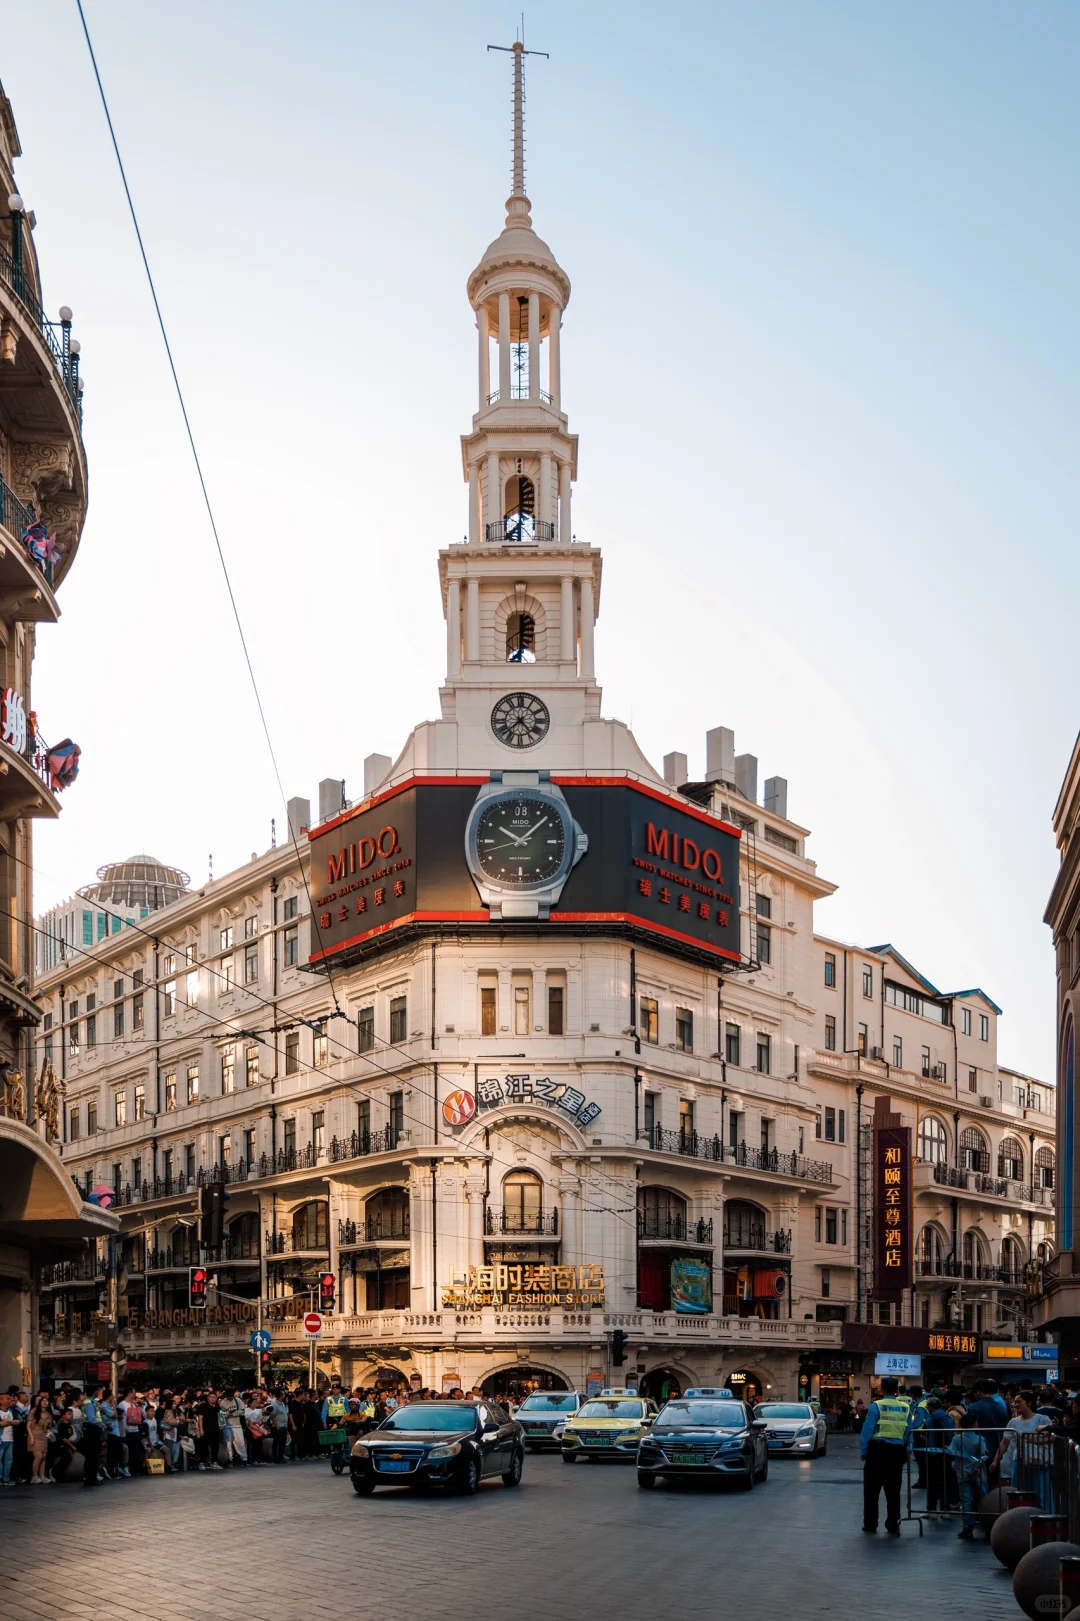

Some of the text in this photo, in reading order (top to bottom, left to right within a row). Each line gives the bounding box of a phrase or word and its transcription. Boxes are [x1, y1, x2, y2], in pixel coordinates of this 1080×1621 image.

[514, 806, 527, 816] 08
[327, 825, 397, 884] MIDO
[646, 821, 722, 880] MIDO
[316, 893, 336, 908] SWISS
[337, 877, 369, 898] WATCHES
[370, 866, 392, 882] SINCE
[633, 856, 657, 873] SWISS
[658, 867, 693, 888] WATCHES
[693, 882, 716, 898] SINCE
[320, 880, 405, 929] 瑞士美度表
[640, 878, 728, 928] 瑞士美度表
[477, 1074, 586, 1116] 锦江之星
[884, 1147, 901, 1267] 和颐至尊酒店
[441, 1264, 605, 1291] 上海时装商店
[144, 1298, 312, 1328] SHANGHAI FASHION STORE
[442, 1293, 605, 1305] SHANGHAI FASHION STORE
[886, 1358, 909, 1369] 上海记忆
[928, 1334, 976, 1352] 和颐至尊酒店
